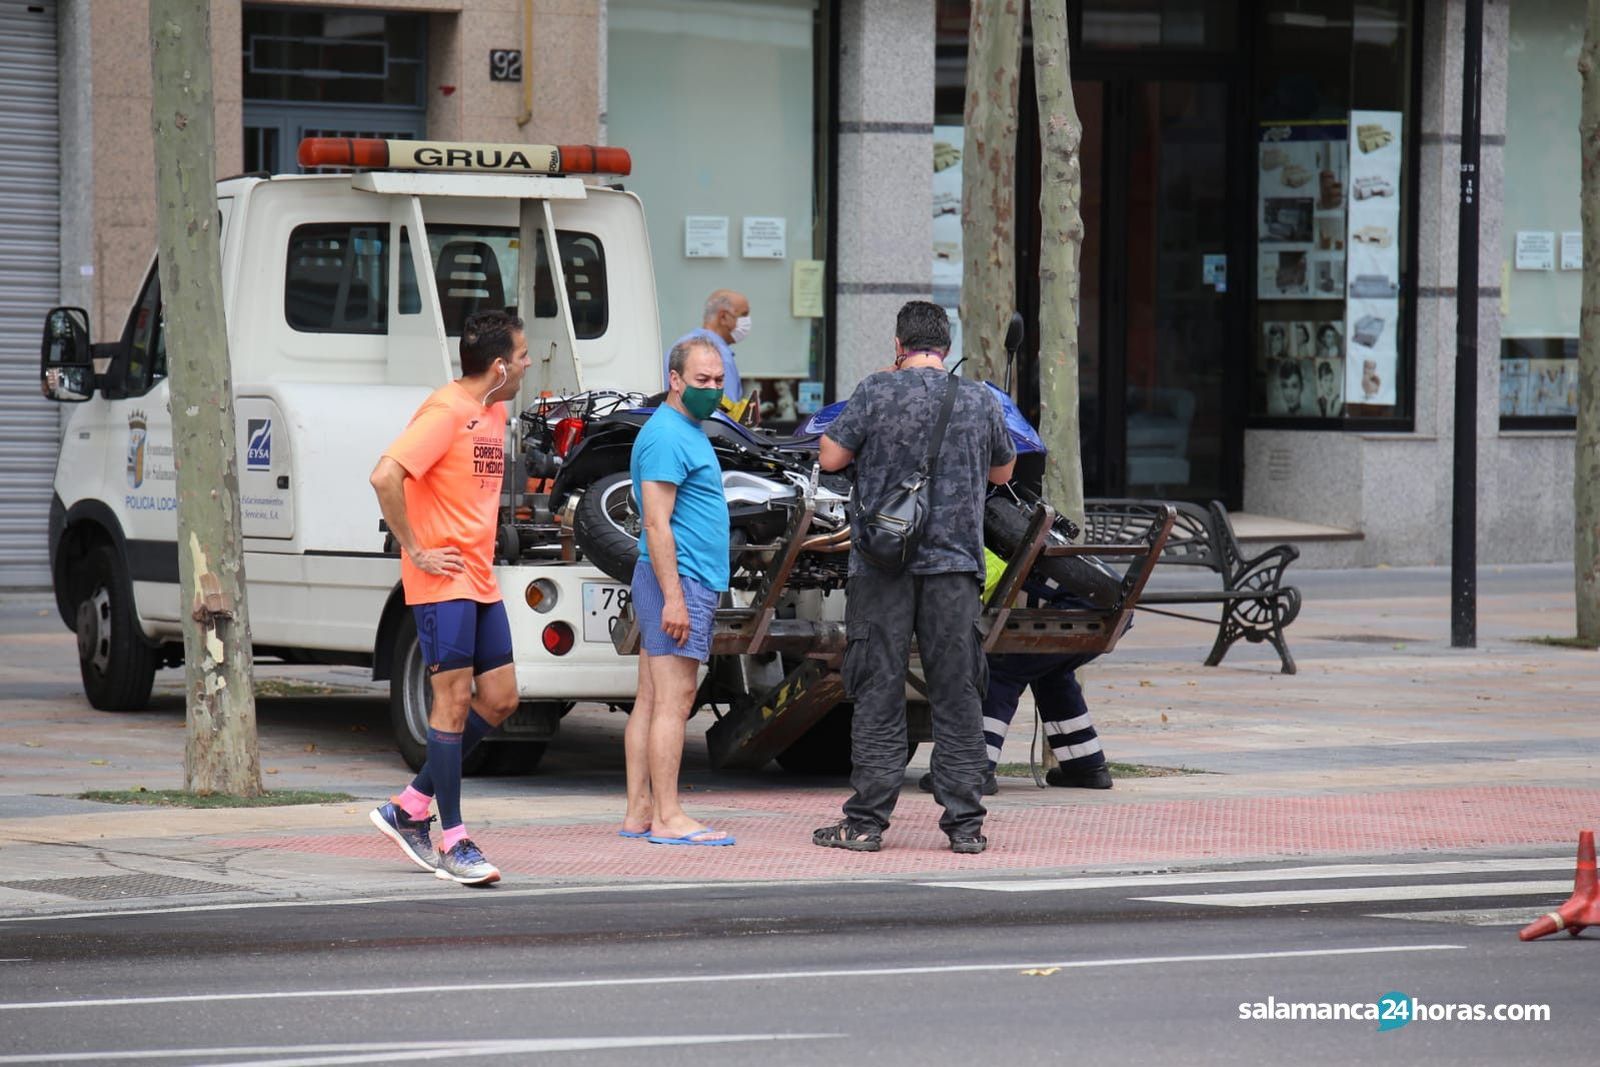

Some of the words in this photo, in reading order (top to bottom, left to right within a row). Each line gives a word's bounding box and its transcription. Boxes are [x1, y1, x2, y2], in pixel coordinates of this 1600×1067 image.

[493, 51, 521, 79] 92
[413, 148, 532, 169] GRUA
[248, 448, 270, 459] EYSA
[472, 460, 484, 473] TU
[157, 497, 177, 511] LOCA
